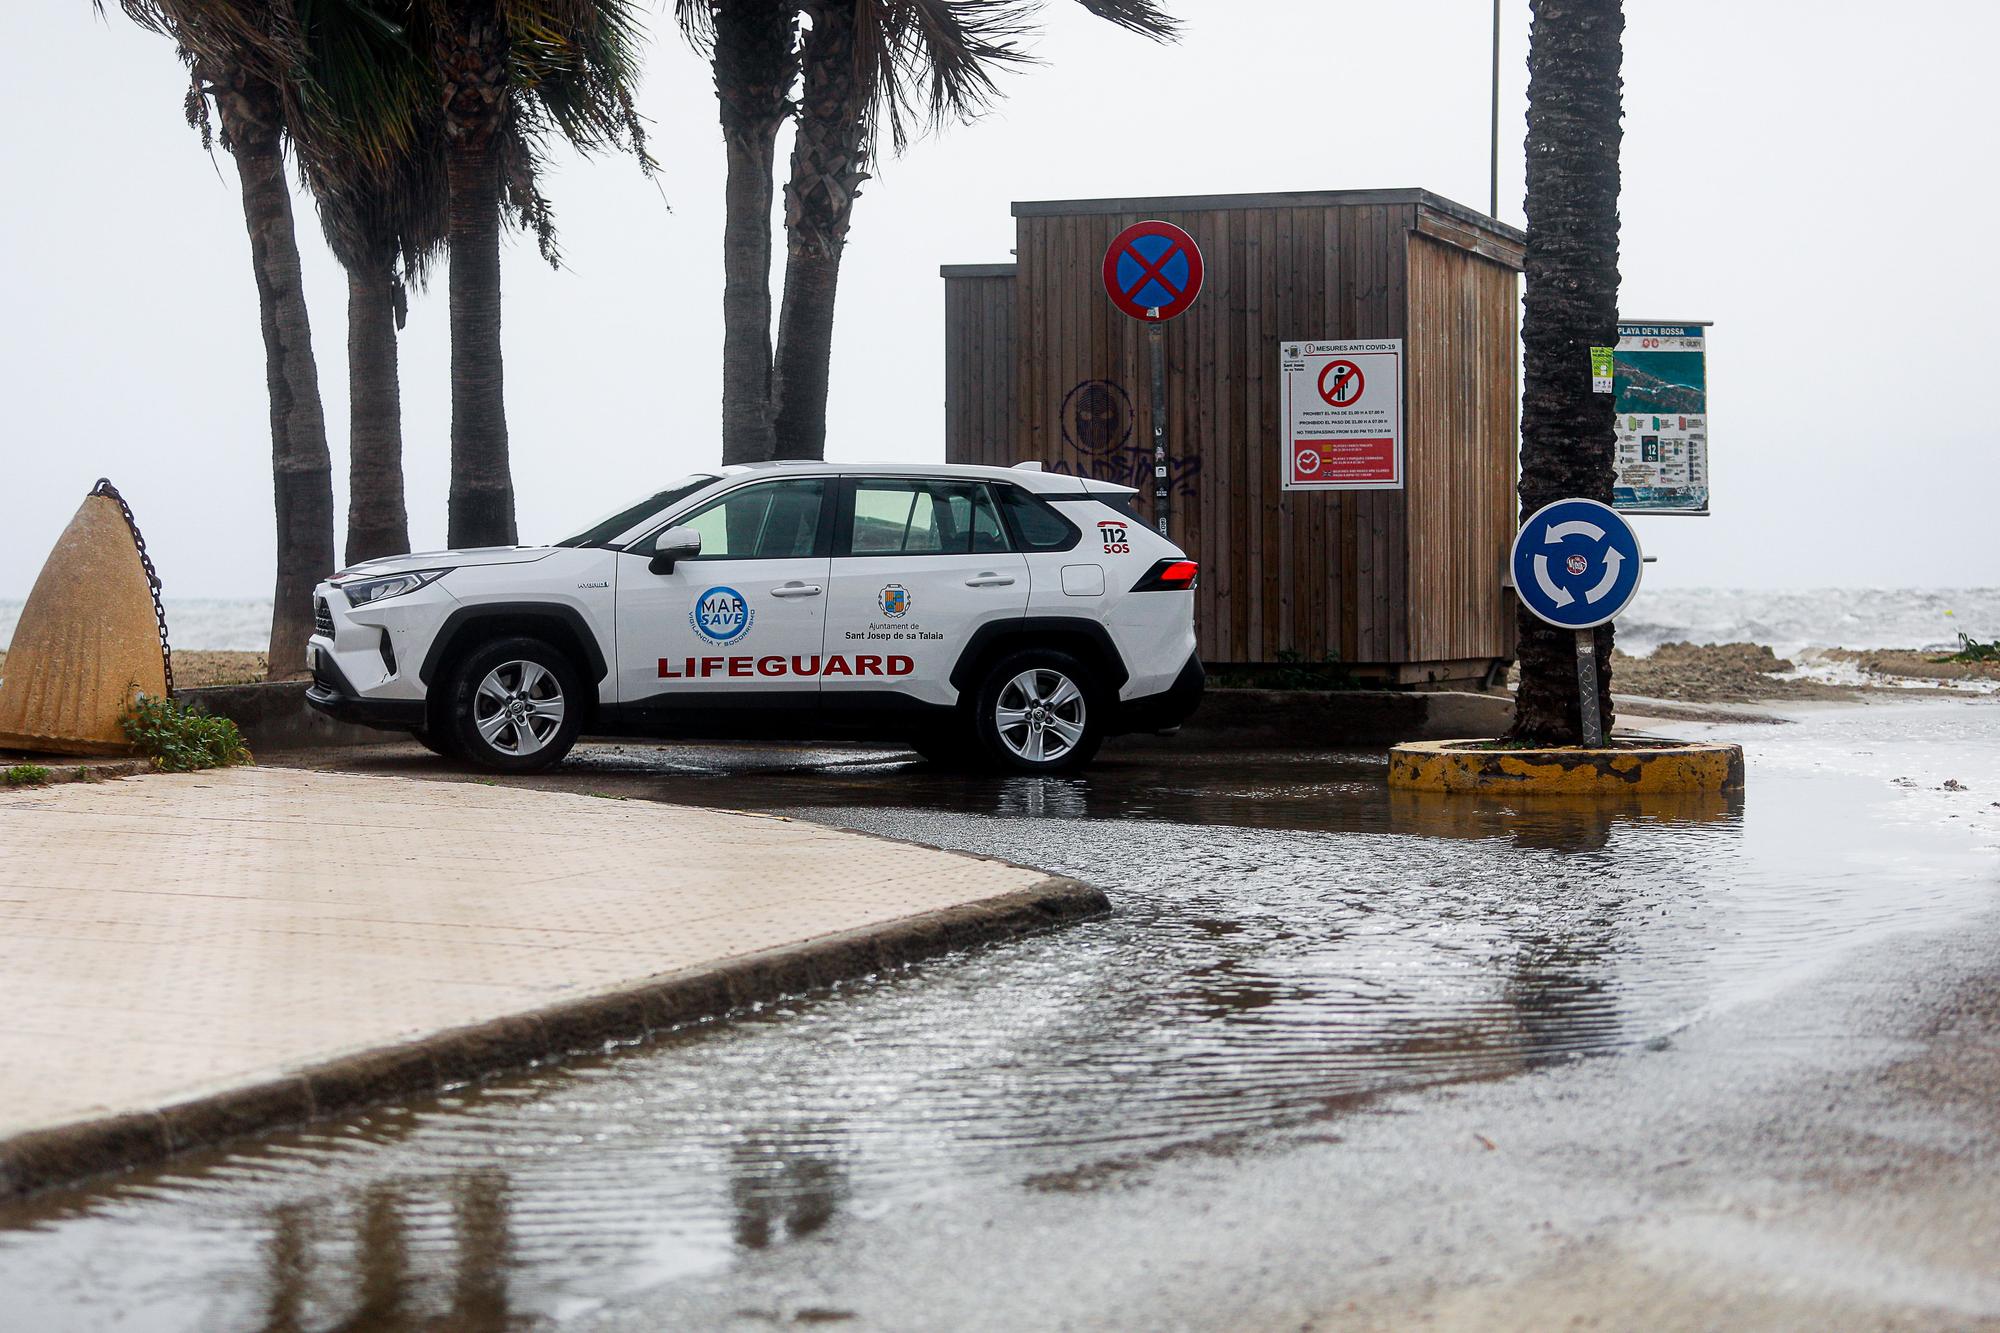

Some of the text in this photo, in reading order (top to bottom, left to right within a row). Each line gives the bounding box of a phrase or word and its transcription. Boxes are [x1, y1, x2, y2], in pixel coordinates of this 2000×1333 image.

[1617, 327, 1640, 335] PLAYA
[1660, 328, 1685, 336] BOSSA
[1647, 444, 1657, 455] 12
[1100, 528, 1128, 543] 112
[1103, 543, 1130, 554] SOS
[701, 598, 744, 614] MAR
[700, 613, 744, 626] SAVE
[688, 611, 714, 646] VIGILANCIA
[869, 622, 920, 631] Ajuntament de
[845, 631, 865, 640] Sant
[866, 631, 891, 641] Josep
[893, 631, 904, 640] de
[918, 631, 944, 640] Talaia
[657, 655, 915, 678] LIFEGUARD
